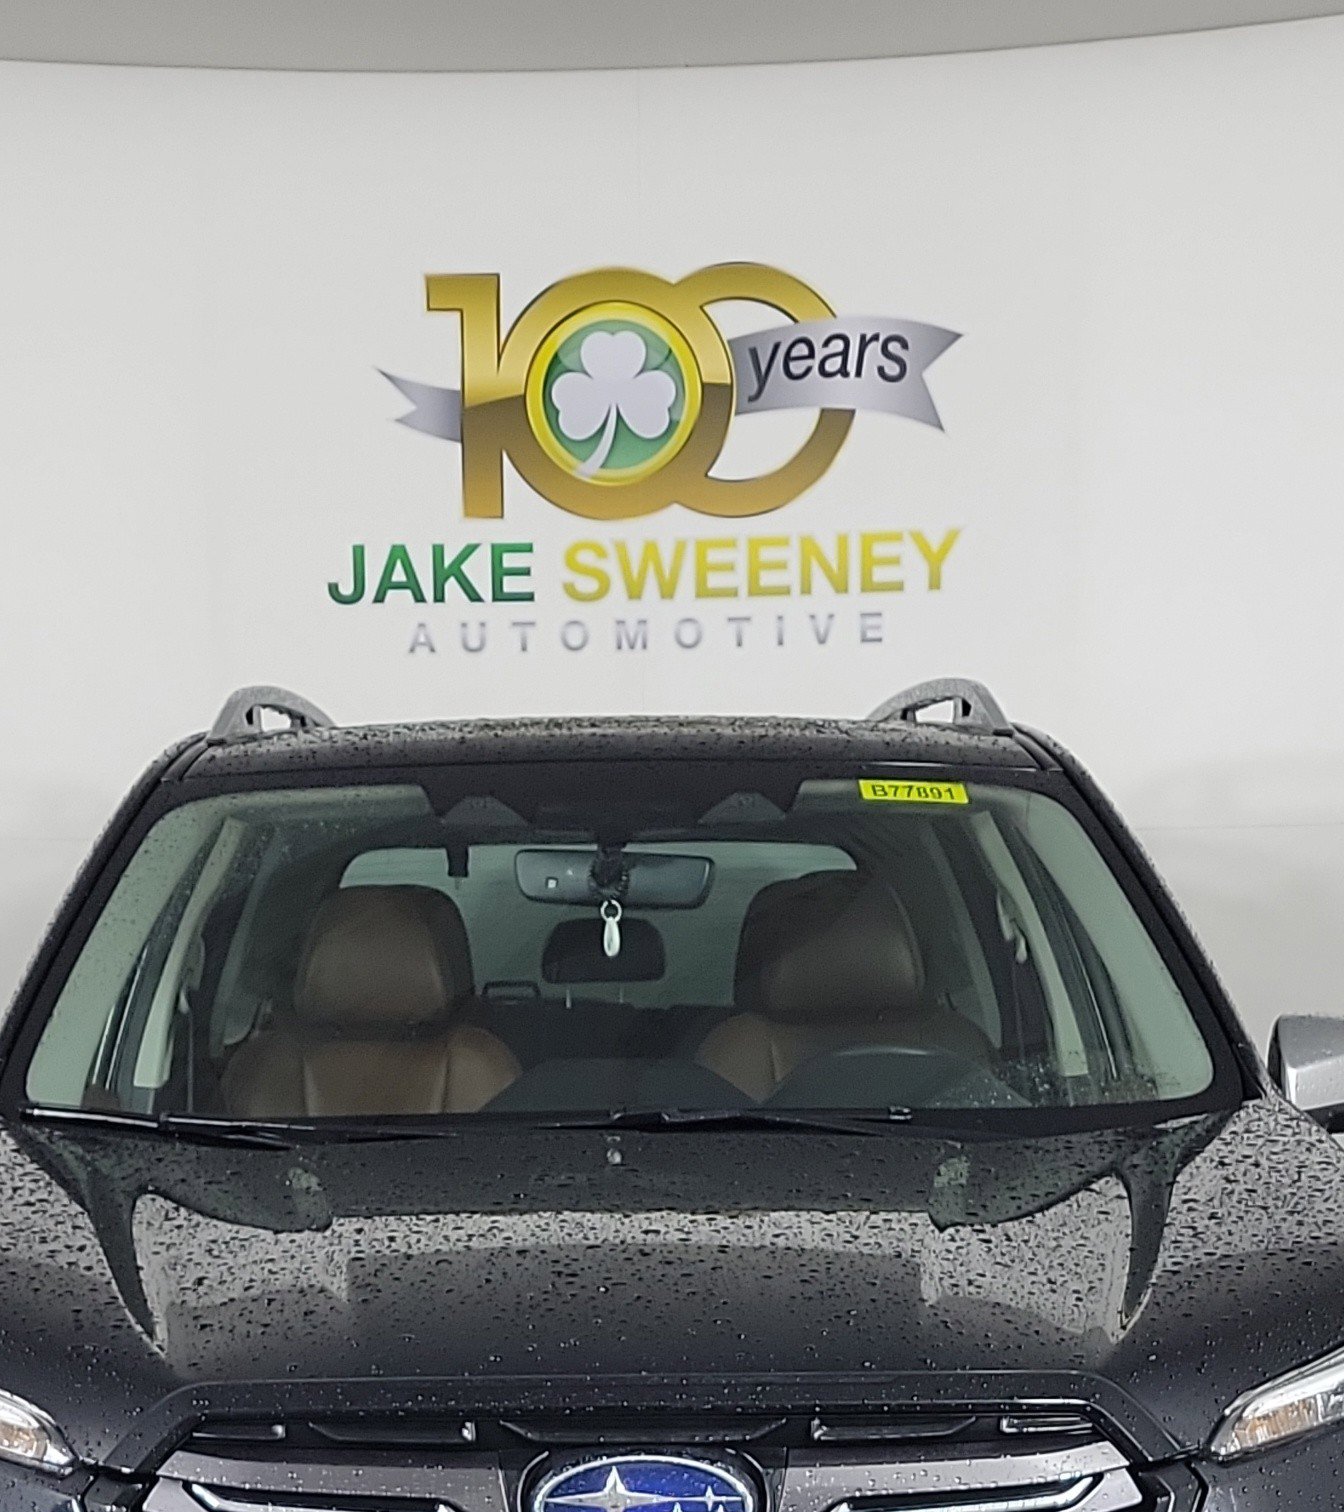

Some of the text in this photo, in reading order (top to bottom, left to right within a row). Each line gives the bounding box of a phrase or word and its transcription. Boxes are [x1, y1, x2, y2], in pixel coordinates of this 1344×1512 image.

[423, 261, 910, 520] 100 years
[327, 528, 964, 606] JAKE SWEENEY
[408, 611, 885, 655] AUTOMOTIVE
